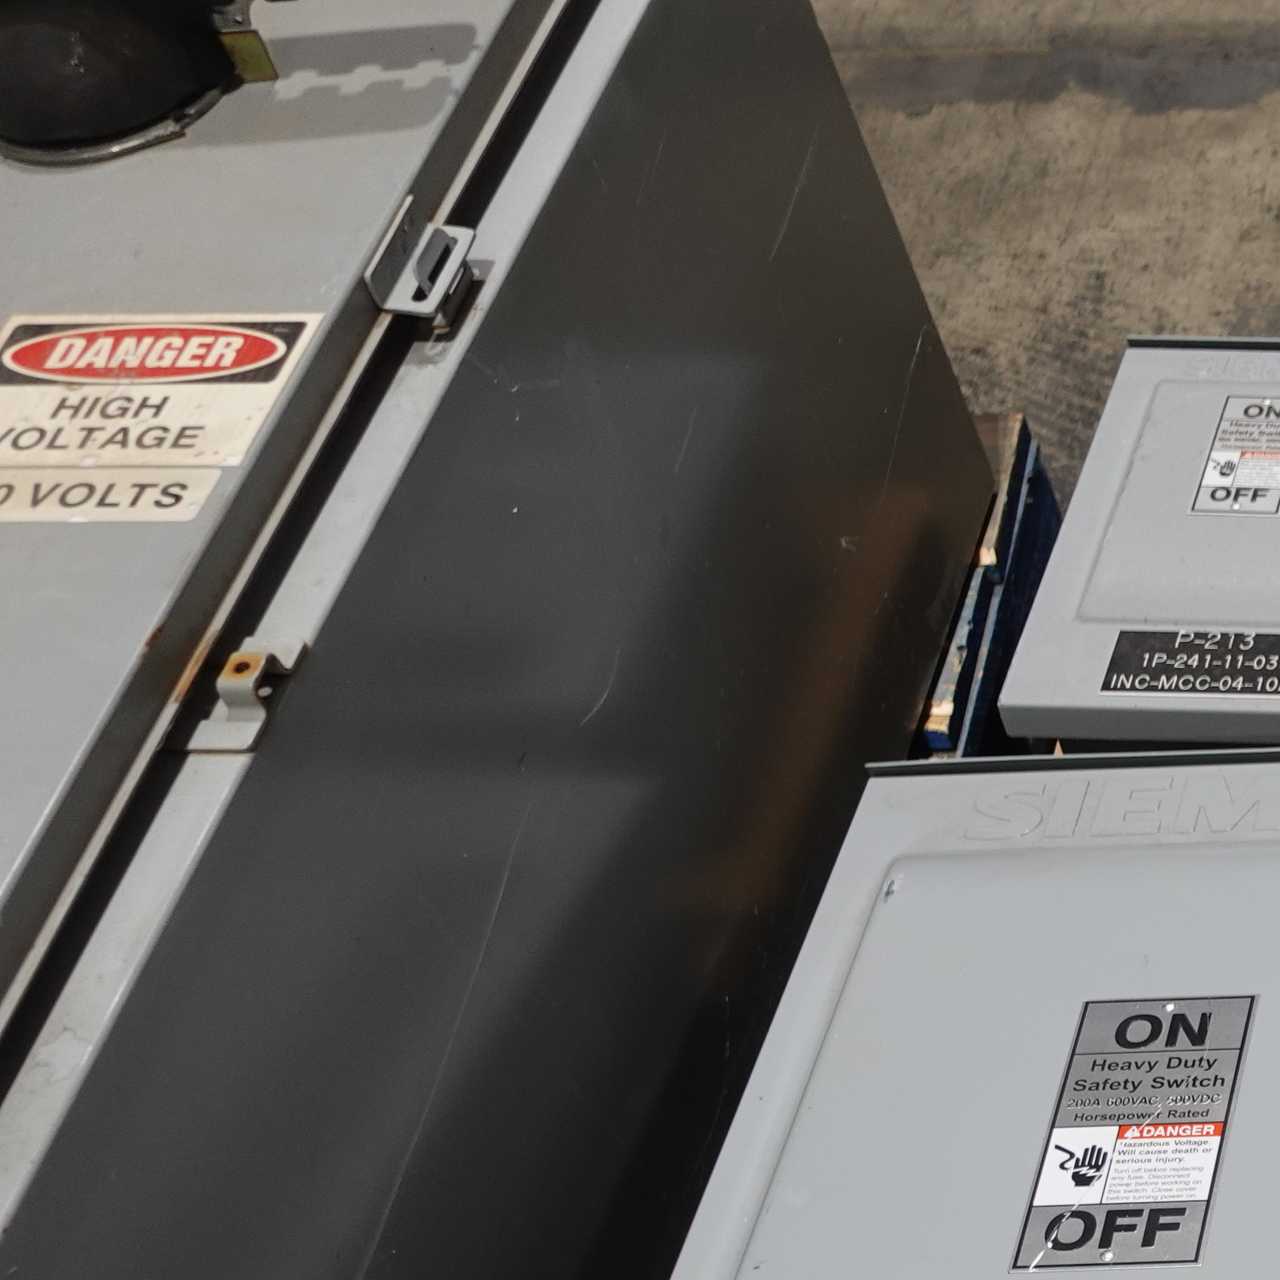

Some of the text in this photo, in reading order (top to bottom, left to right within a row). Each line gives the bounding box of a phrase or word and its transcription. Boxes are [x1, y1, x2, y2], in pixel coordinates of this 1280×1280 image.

[44, 335, 245, 369] DANGER
[50, 396, 171, 420] HIGH
[29, 482, 190, 508] VOLTS
[1210, 486, 1270, 502] OFF
[1174, 631, 1257, 650] P-213
[1142, 652, 1280, 670] 1P-241-11-03
[1114, 1012, 1213, 1049] ON
[1091, 1056, 1218, 1073] Heavy Duty
[1072, 1075, 1225, 1093] Safety Switch
[1073, 1108, 1211, 1123] Horsepower Rated
[1142, 1125, 1215, 1137] DANGER
[1044, 1207, 1188, 1251] OFF
